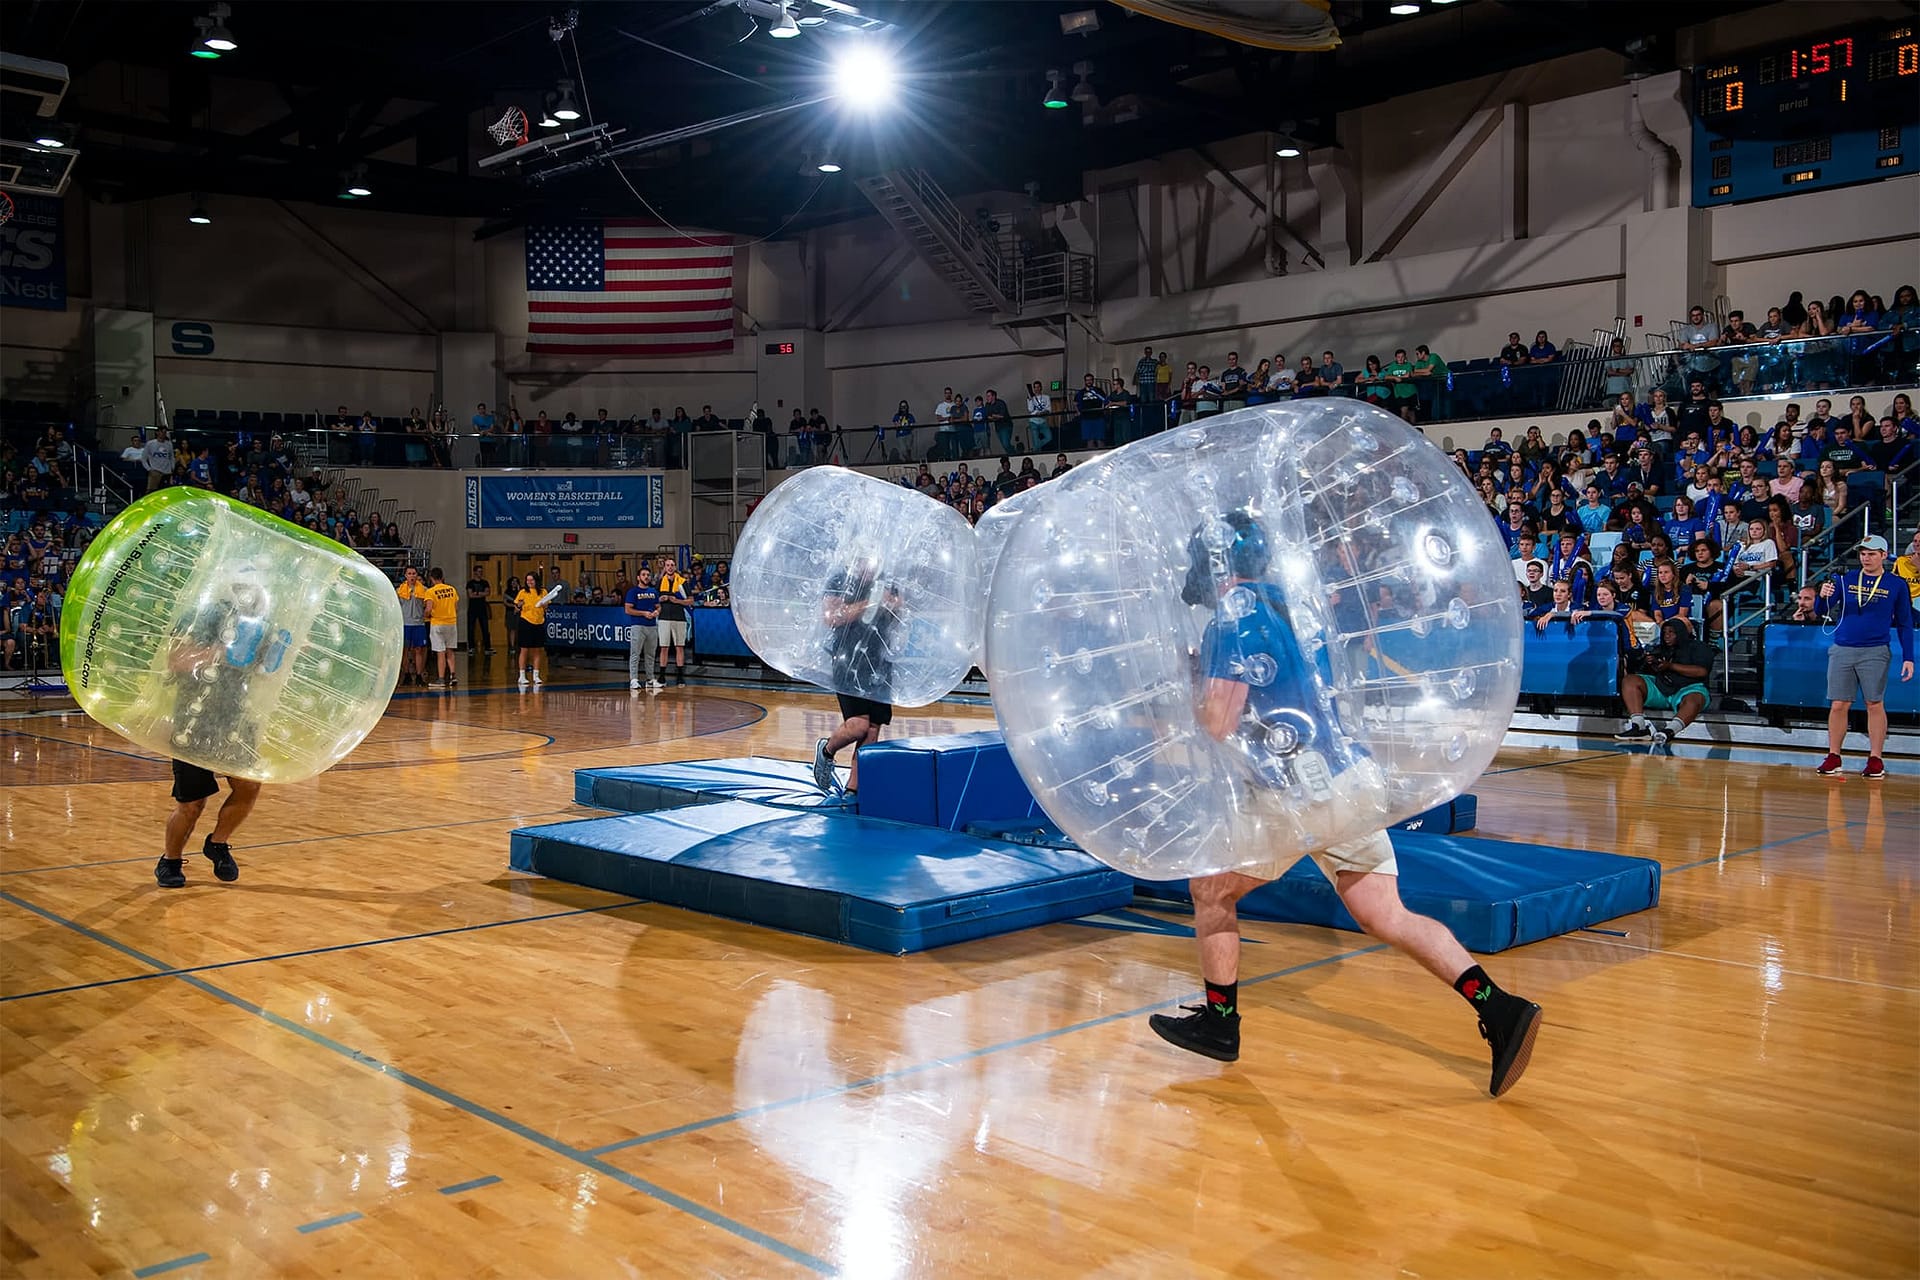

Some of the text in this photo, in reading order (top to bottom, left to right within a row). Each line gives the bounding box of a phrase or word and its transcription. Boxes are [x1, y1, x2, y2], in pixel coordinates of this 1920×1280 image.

[1706, 65, 1739, 80] Eagles
[1791, 38, 1853, 78] 1:57
[1898, 43, 1919, 76] 0
[1725, 81, 1744, 112] 0
[1779, 98, 1809, 112] period
[171, 322, 215, 355] S
[780, 343, 792, 353] 56
[467, 479, 478, 526] EAGLES
[506, 491, 623, 501] WOMEN'S BASKETBALL
[652, 478, 662, 525] EAGLES
[82, 523, 164, 688] www.BubbleBumpSoccer.com
[547, 623, 612, 644] @EaglesPCC
